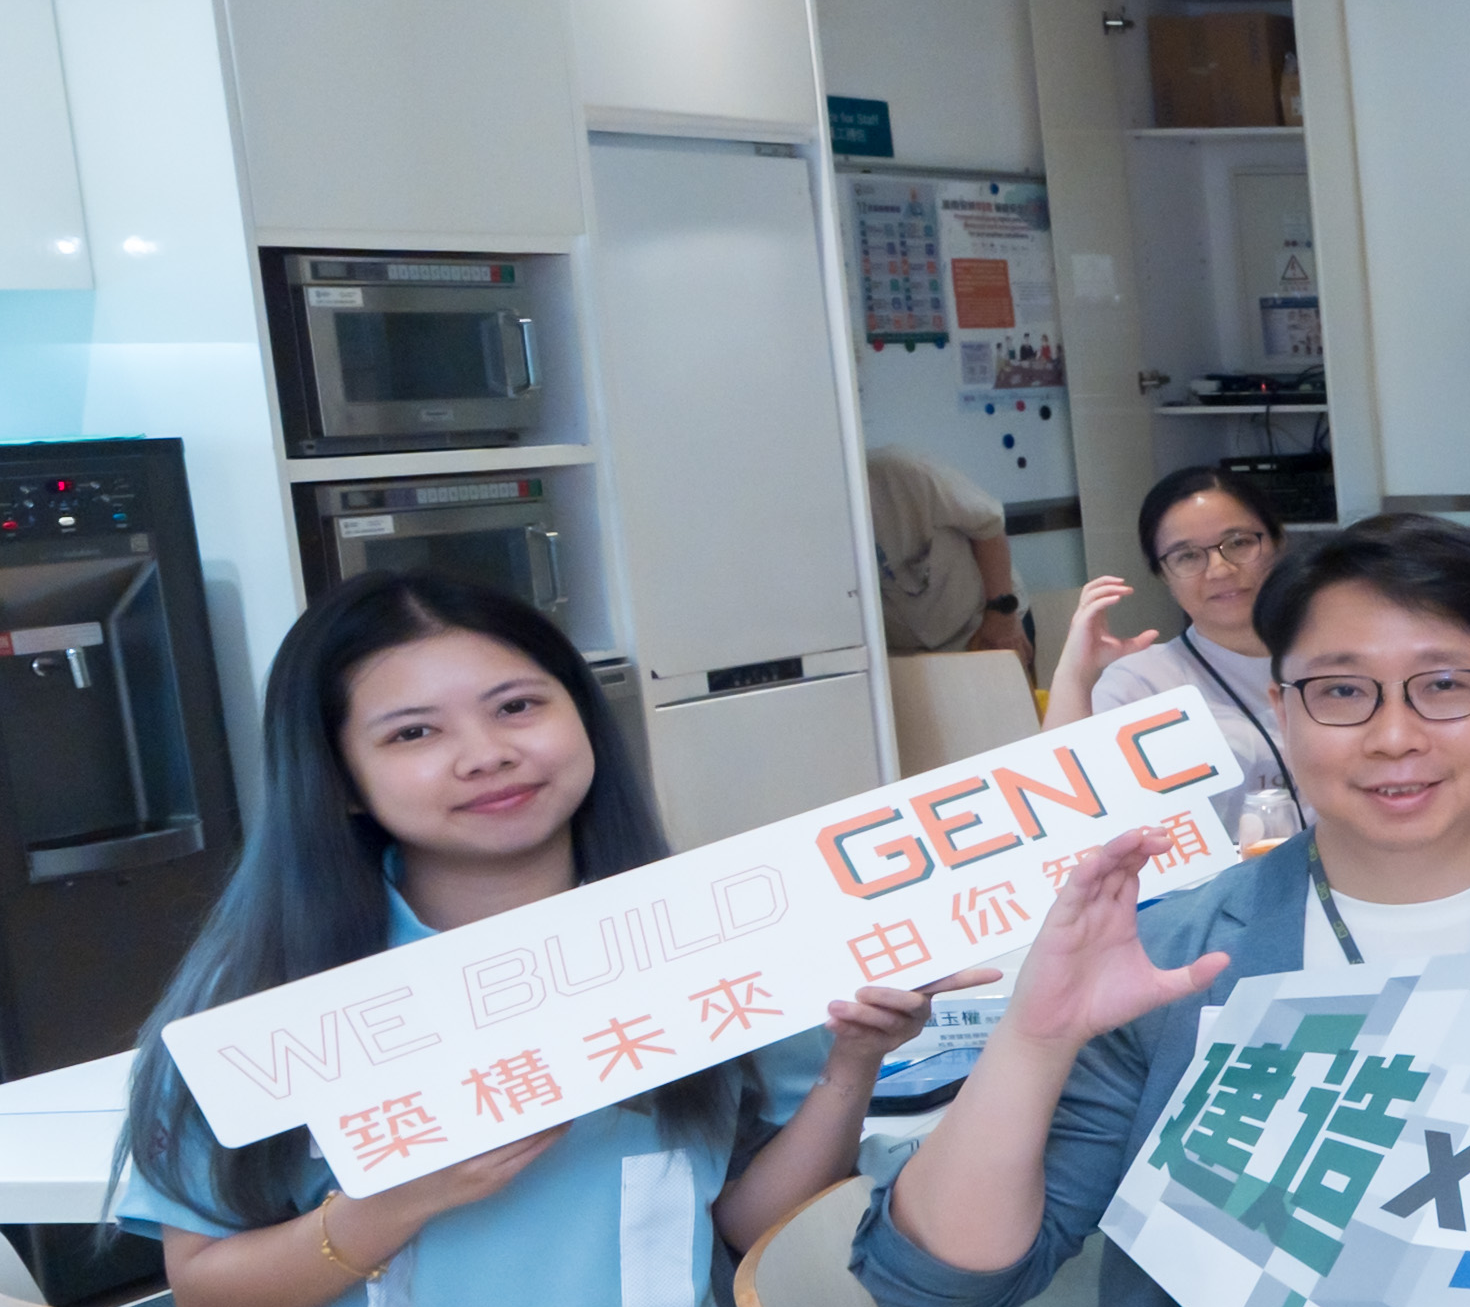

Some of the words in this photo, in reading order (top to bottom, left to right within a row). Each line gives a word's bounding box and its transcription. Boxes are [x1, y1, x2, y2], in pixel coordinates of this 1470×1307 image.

[217, 986, 442, 1100] WE
[462, 864, 789, 1030] BUILD
[815, 745, 1107, 900] GEN
[1115, 708, 1219, 794] C
[339, 970, 785, 1172] 築構未來
